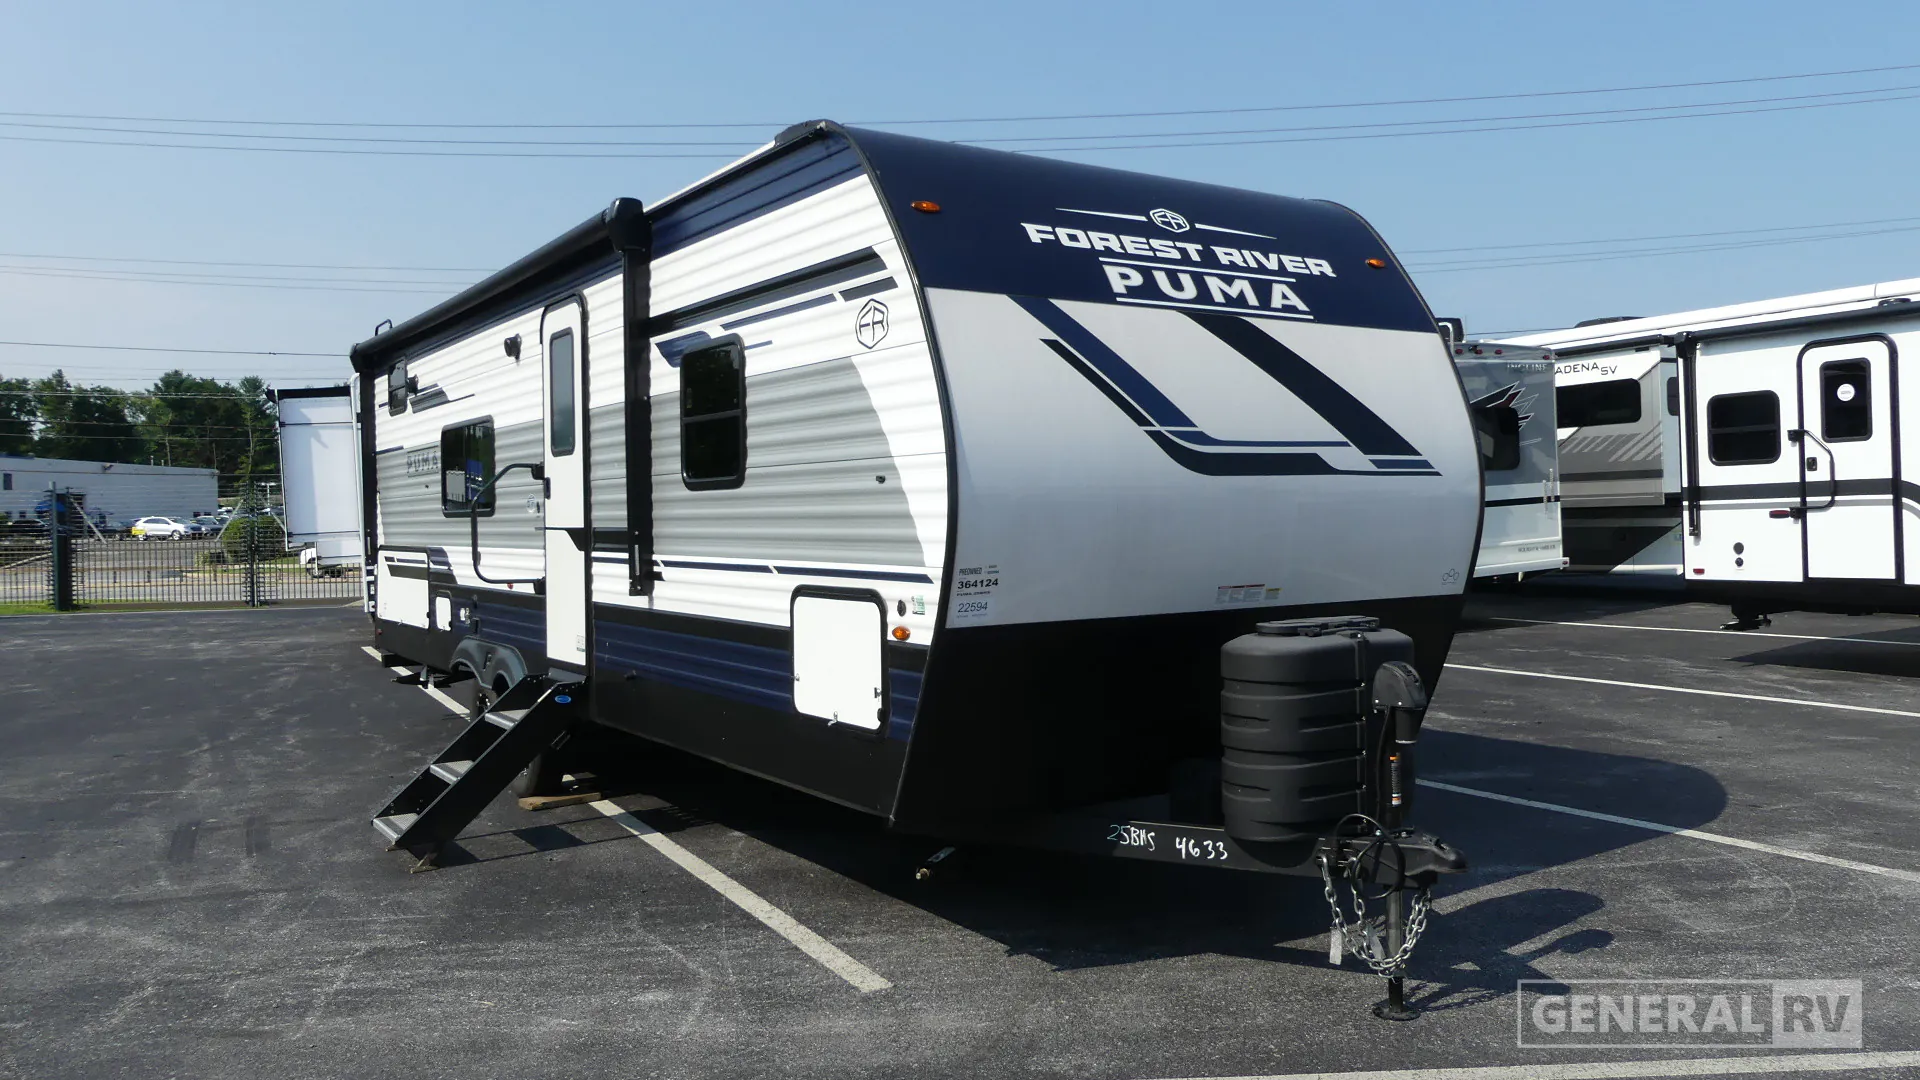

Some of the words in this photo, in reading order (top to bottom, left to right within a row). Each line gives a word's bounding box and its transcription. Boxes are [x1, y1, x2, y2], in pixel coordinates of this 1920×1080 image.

[1020, 222, 1203, 262] FOREST
[1210, 245, 1337, 278] RIVER
[1102, 264, 1311, 312] PUMA
[1554, 362, 1599, 375] ADENA
[1600, 365, 1618, 375] SV
[407, 451, 438, 474] PUMA
[957, 578, 999, 589] 364124
[957, 601, 988, 613] 22594
[1175, 836, 1228, 860] 4633
